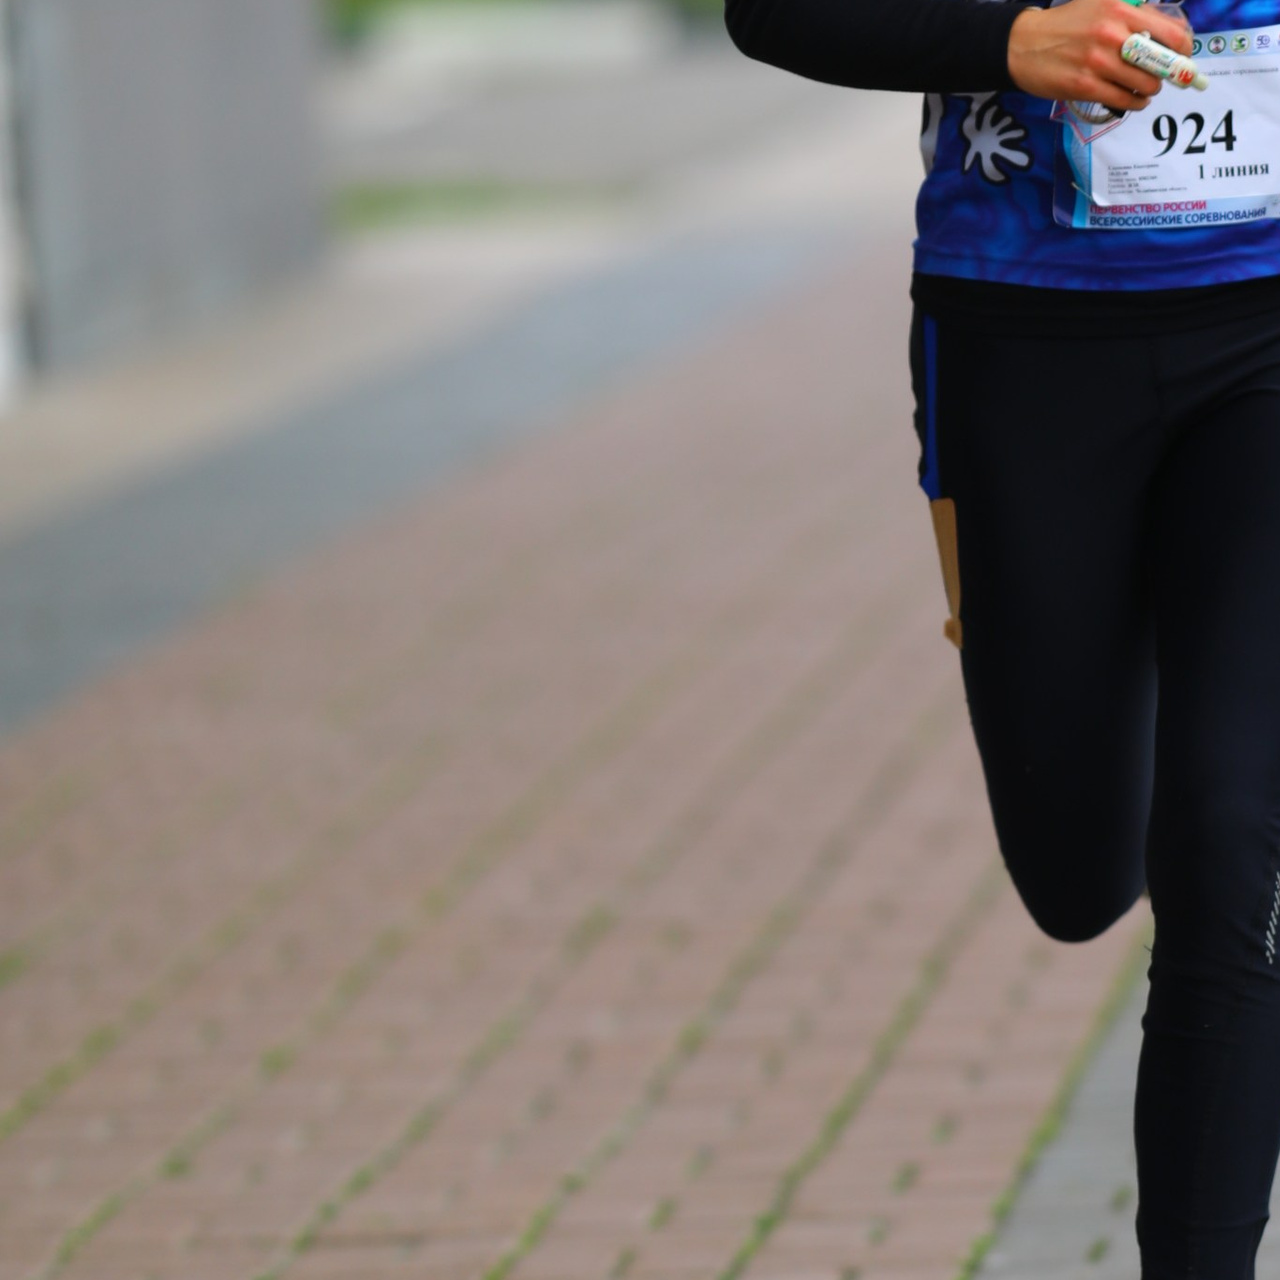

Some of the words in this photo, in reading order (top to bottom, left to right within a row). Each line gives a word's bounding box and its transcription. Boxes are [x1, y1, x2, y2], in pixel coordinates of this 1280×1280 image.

[1152, 109, 1237, 158] 924
[1198, 164, 1204, 179] 1
[1212, 163, 1269, 178] линия
[1163, 200, 1207, 212] РОССИИ
[1184, 207, 1267, 223] СОРЕВНОВАНИЯ
